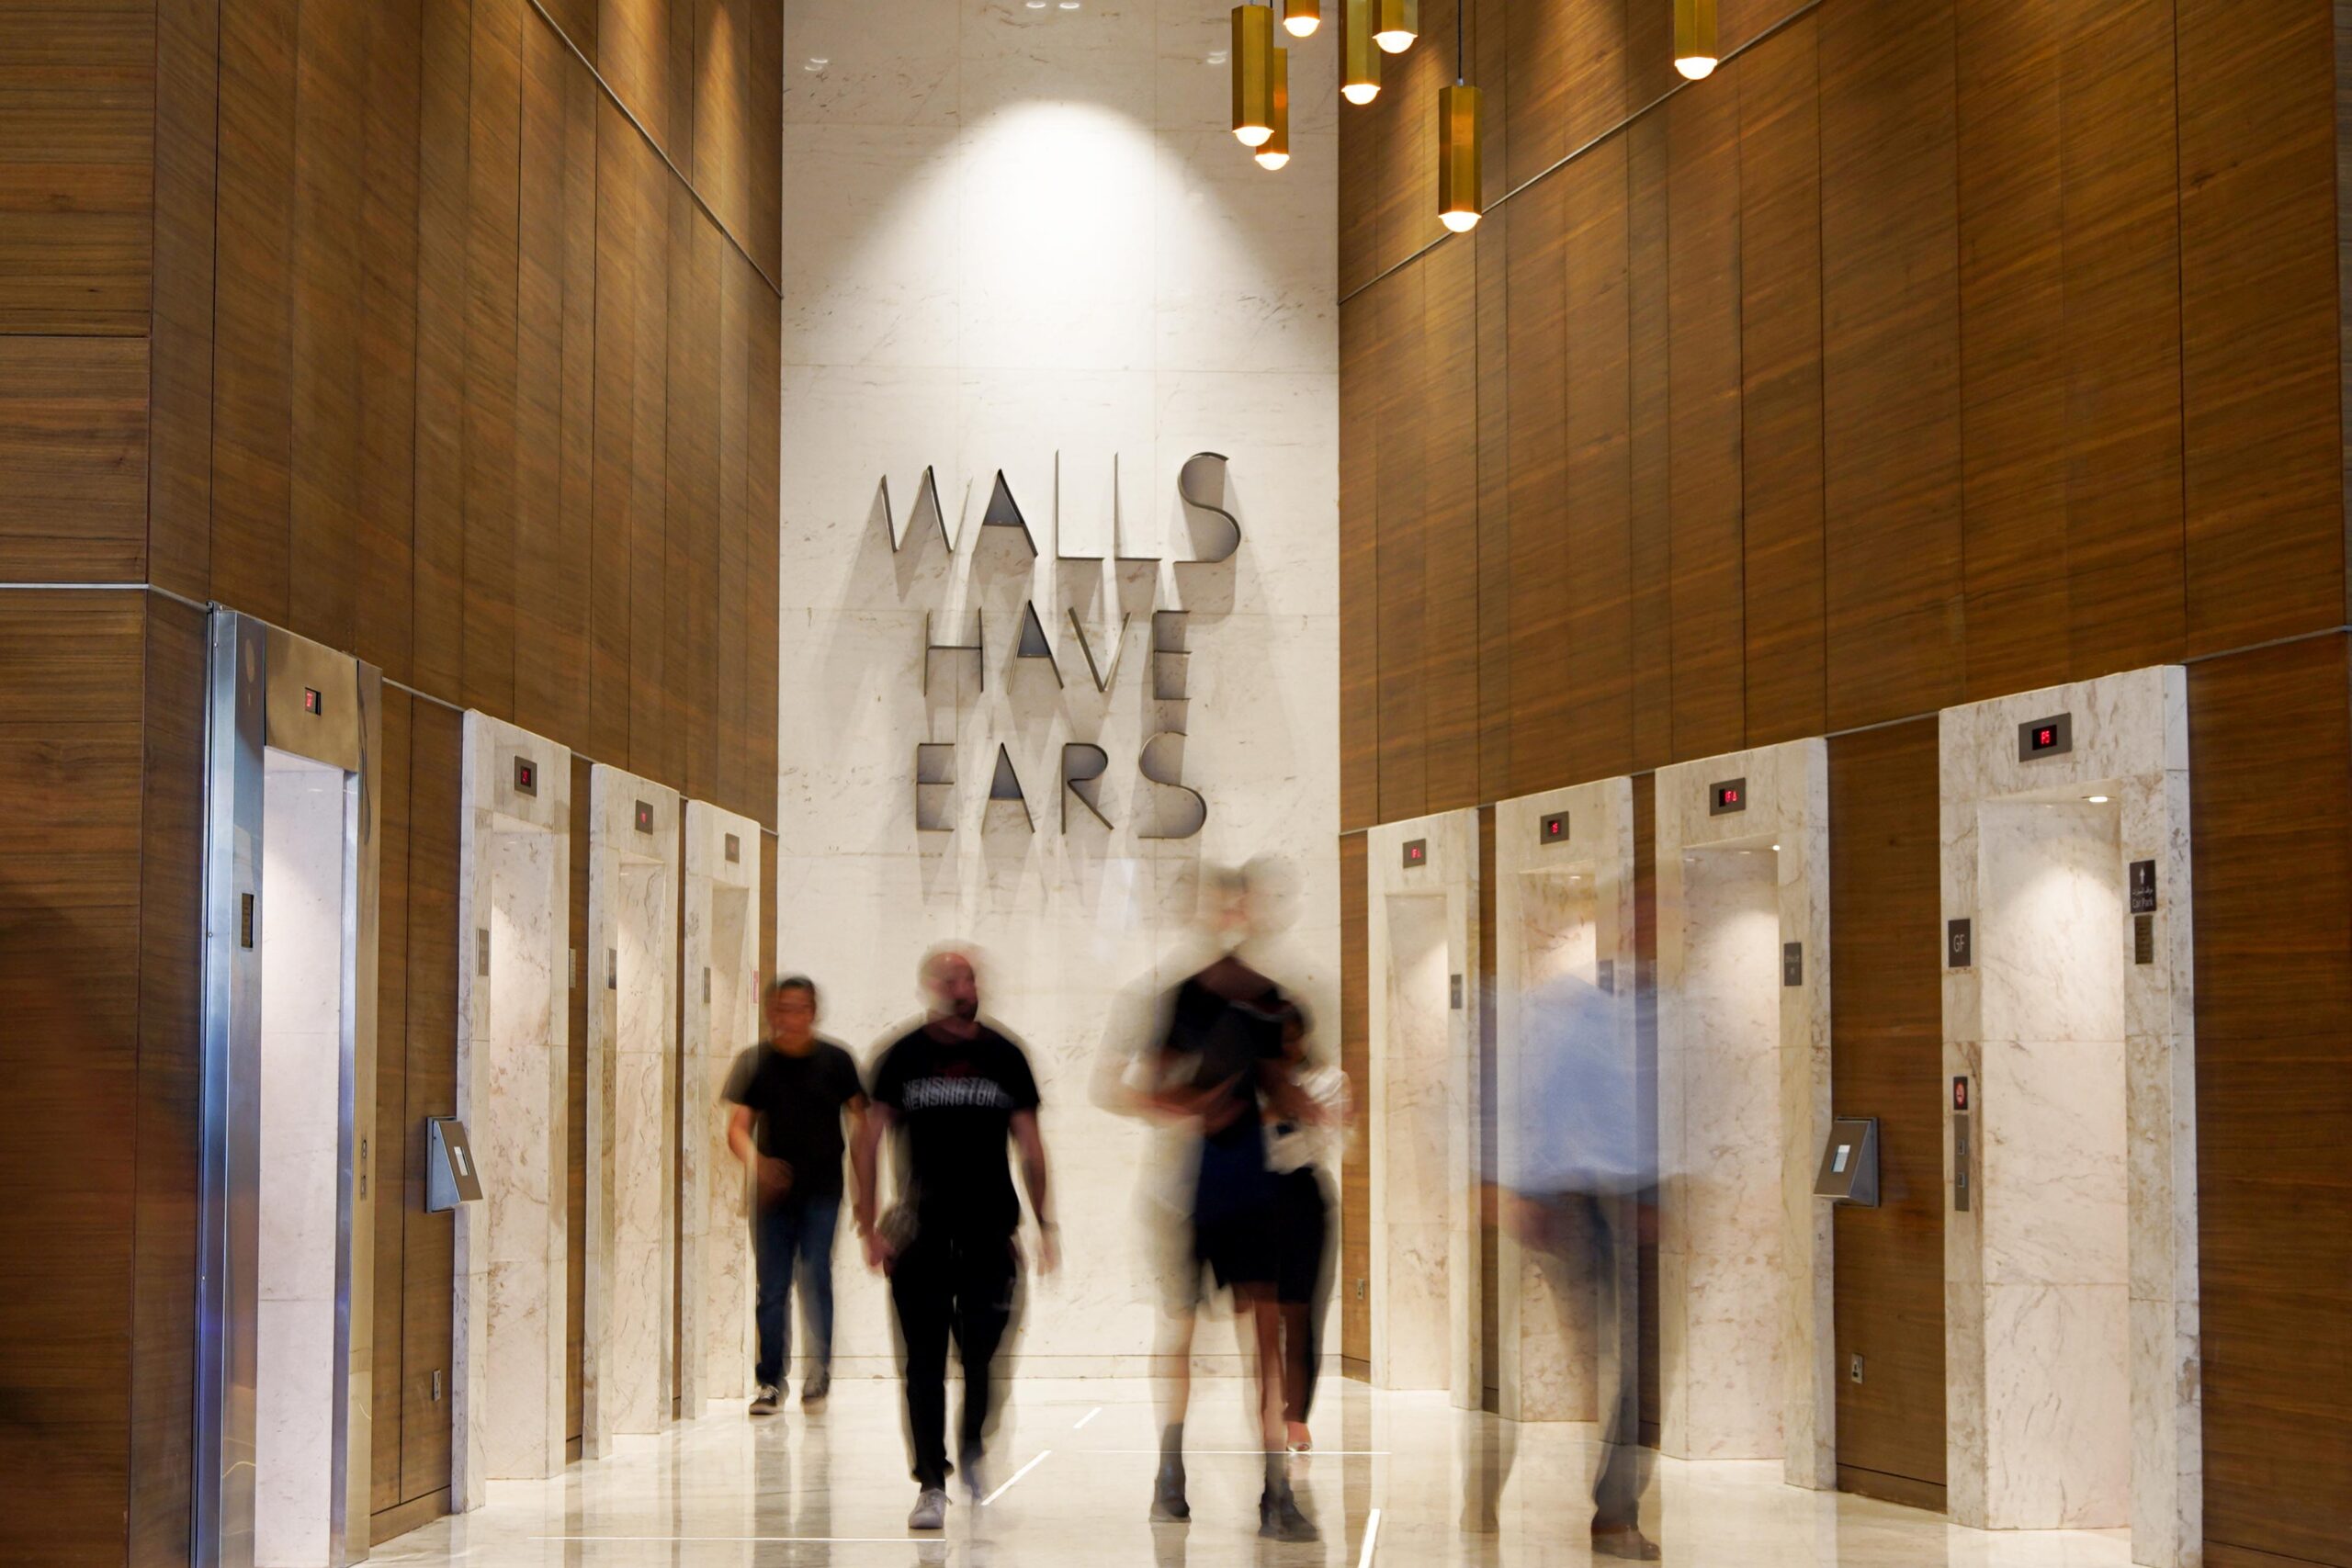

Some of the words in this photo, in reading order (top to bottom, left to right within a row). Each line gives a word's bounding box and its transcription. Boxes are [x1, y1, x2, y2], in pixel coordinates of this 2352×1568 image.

[879, 449, 1241, 563] WALLS
[923, 599, 1193, 701] HAVE
[915, 731, 1207, 840] EARS
[1953, 933, 1965, 953] GF
